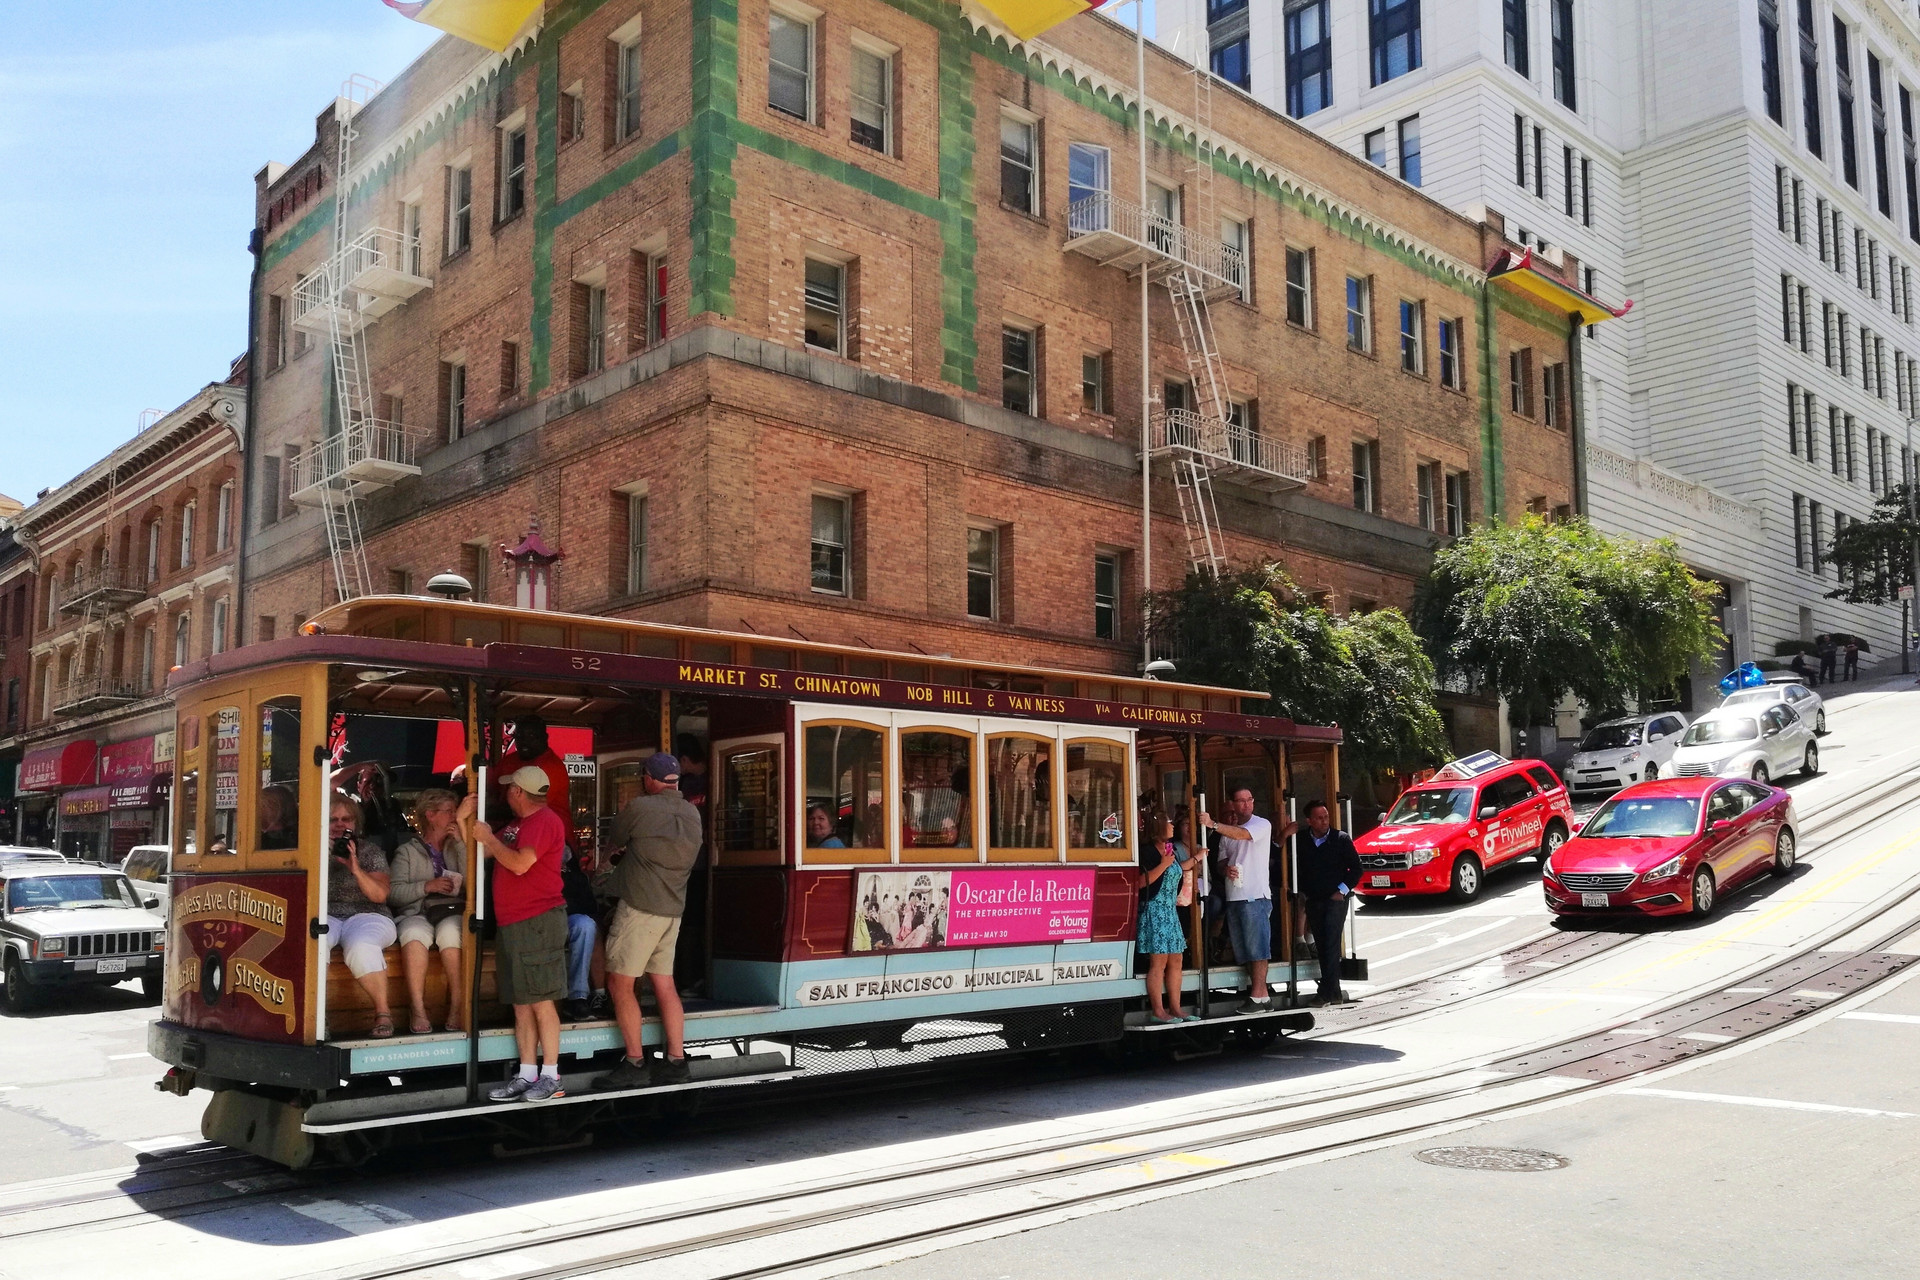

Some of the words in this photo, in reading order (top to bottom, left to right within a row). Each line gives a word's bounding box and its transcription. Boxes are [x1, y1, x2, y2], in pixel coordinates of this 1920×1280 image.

[571, 656, 601, 670] 52
[679, 665, 746, 686] MARKET
[759, 673, 781, 689] ST.
[795, 677, 881, 697] CHINATOWN
[907, 686, 933, 702] NOB
[943, 689, 972, 705] HILL
[987, 694, 995, 707] &
[1009, 696, 1031, 711] VAN
[1036, 698, 1065, 713] NESS
[1095, 703, 1110, 715] VIA
[1122, 707, 1187, 723] CALIFORNIA
[1245, 719, 1260, 728] 52
[567, 764, 594, 774] FORN
[1500, 815, 1543, 844] Flywheel
[956, 881, 1005, 905] Oscar
[1007, 880, 1027, 903] de
[1029, 880, 1043, 902] la
[1045, 880, 1091, 902] Renta
[955, 910, 971, 918] THE
[976, 907, 1042, 918] RETROSPECTIVE
[1049, 916, 1061, 928] de
[1062, 915, 1088, 928] Young
[203, 922, 228, 949] 52
[953, 932, 968, 940] MAR
[1000, 930, 1008, 938] 30
[235, 963, 286, 1003] Streets
[809, 985, 848, 1001] SAN
[855, 974, 954, 997] FRANCISCO
[964, 967, 1044, 988] MUNICIPAL
[1053, 963, 1113, 980] RAILWAY
[433, 1048, 455, 1056] ONLY
